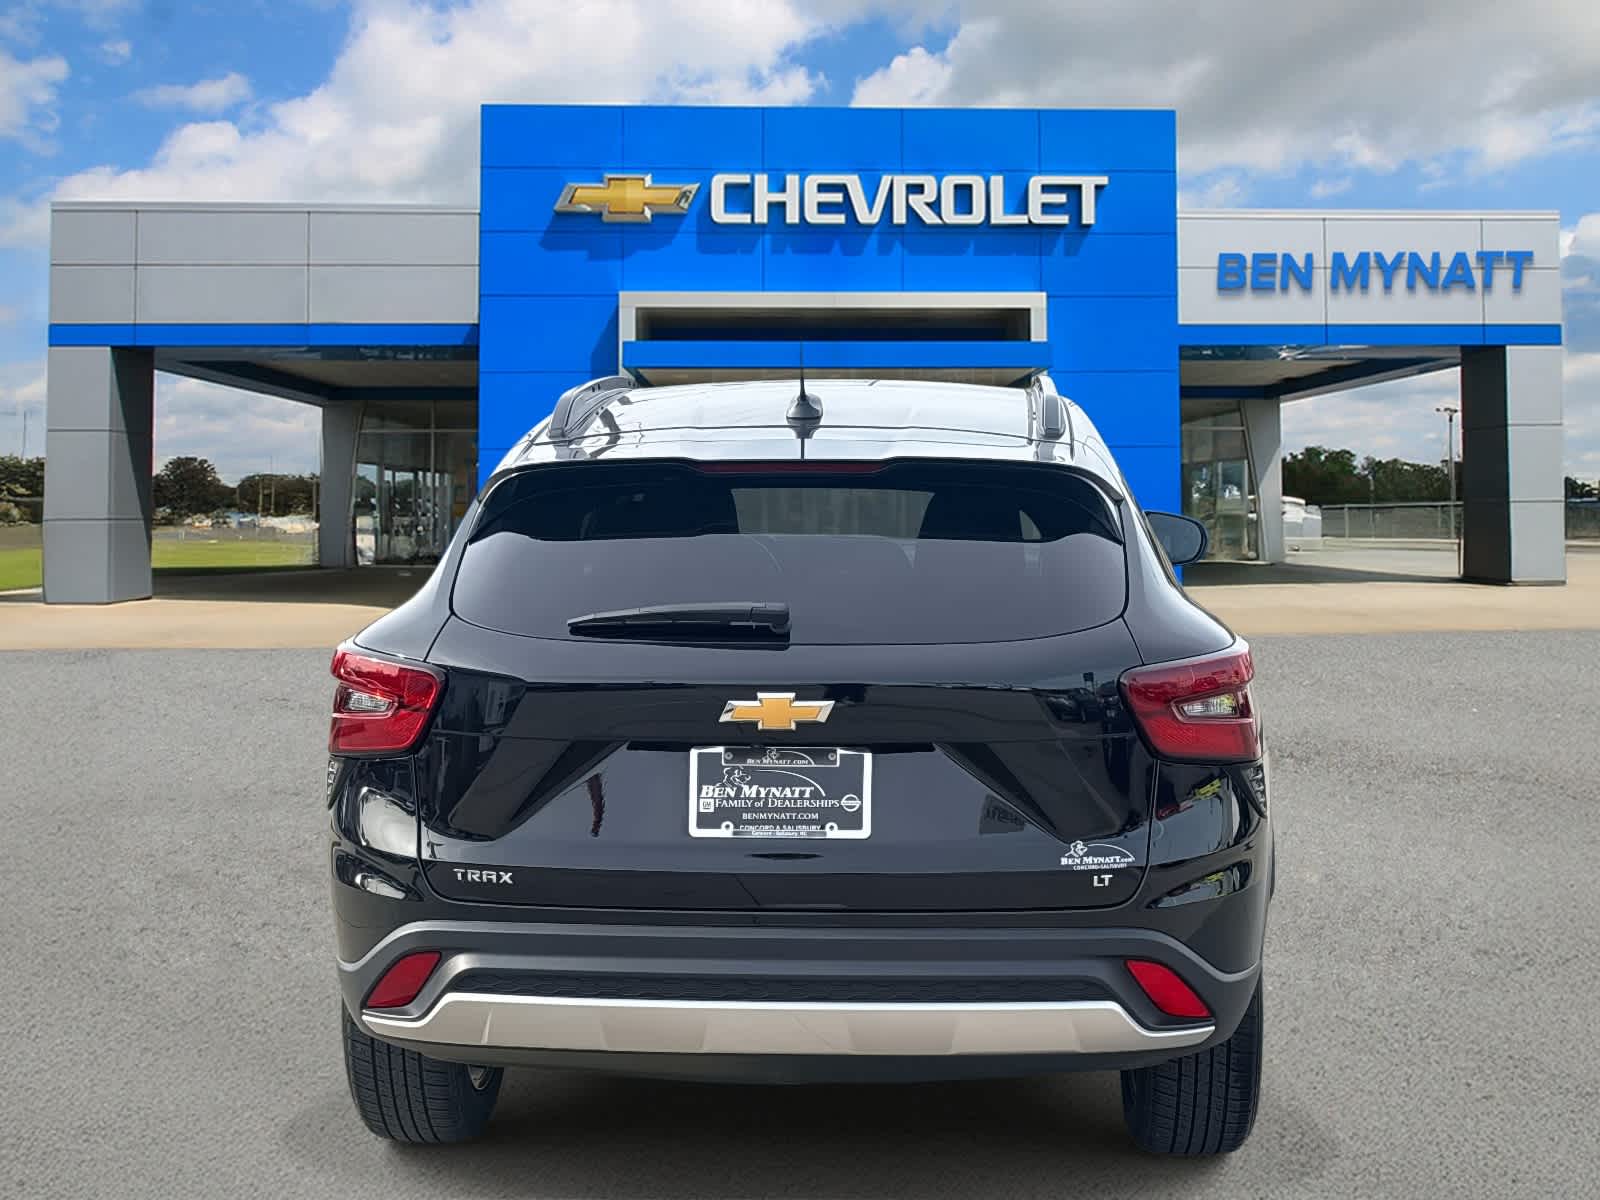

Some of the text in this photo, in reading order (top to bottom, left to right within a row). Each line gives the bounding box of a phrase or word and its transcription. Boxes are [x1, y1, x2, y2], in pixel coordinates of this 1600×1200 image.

[710, 173, 1109, 225] CHEVROLET
[1217, 250, 1534, 291] BEN MYNATT
[700, 784, 815, 798] BEN MYNATT
[715, 799, 753, 808] FAMILY
[754, 799, 765, 808] of
[767, 799, 840, 808] DEALERSHIPS
[742, 812, 819, 820] BENMYNATT.COM
[1060, 857, 1081, 865] BEN
[453, 868, 513, 884] TRAX
[1093, 874, 1113, 887] LT
